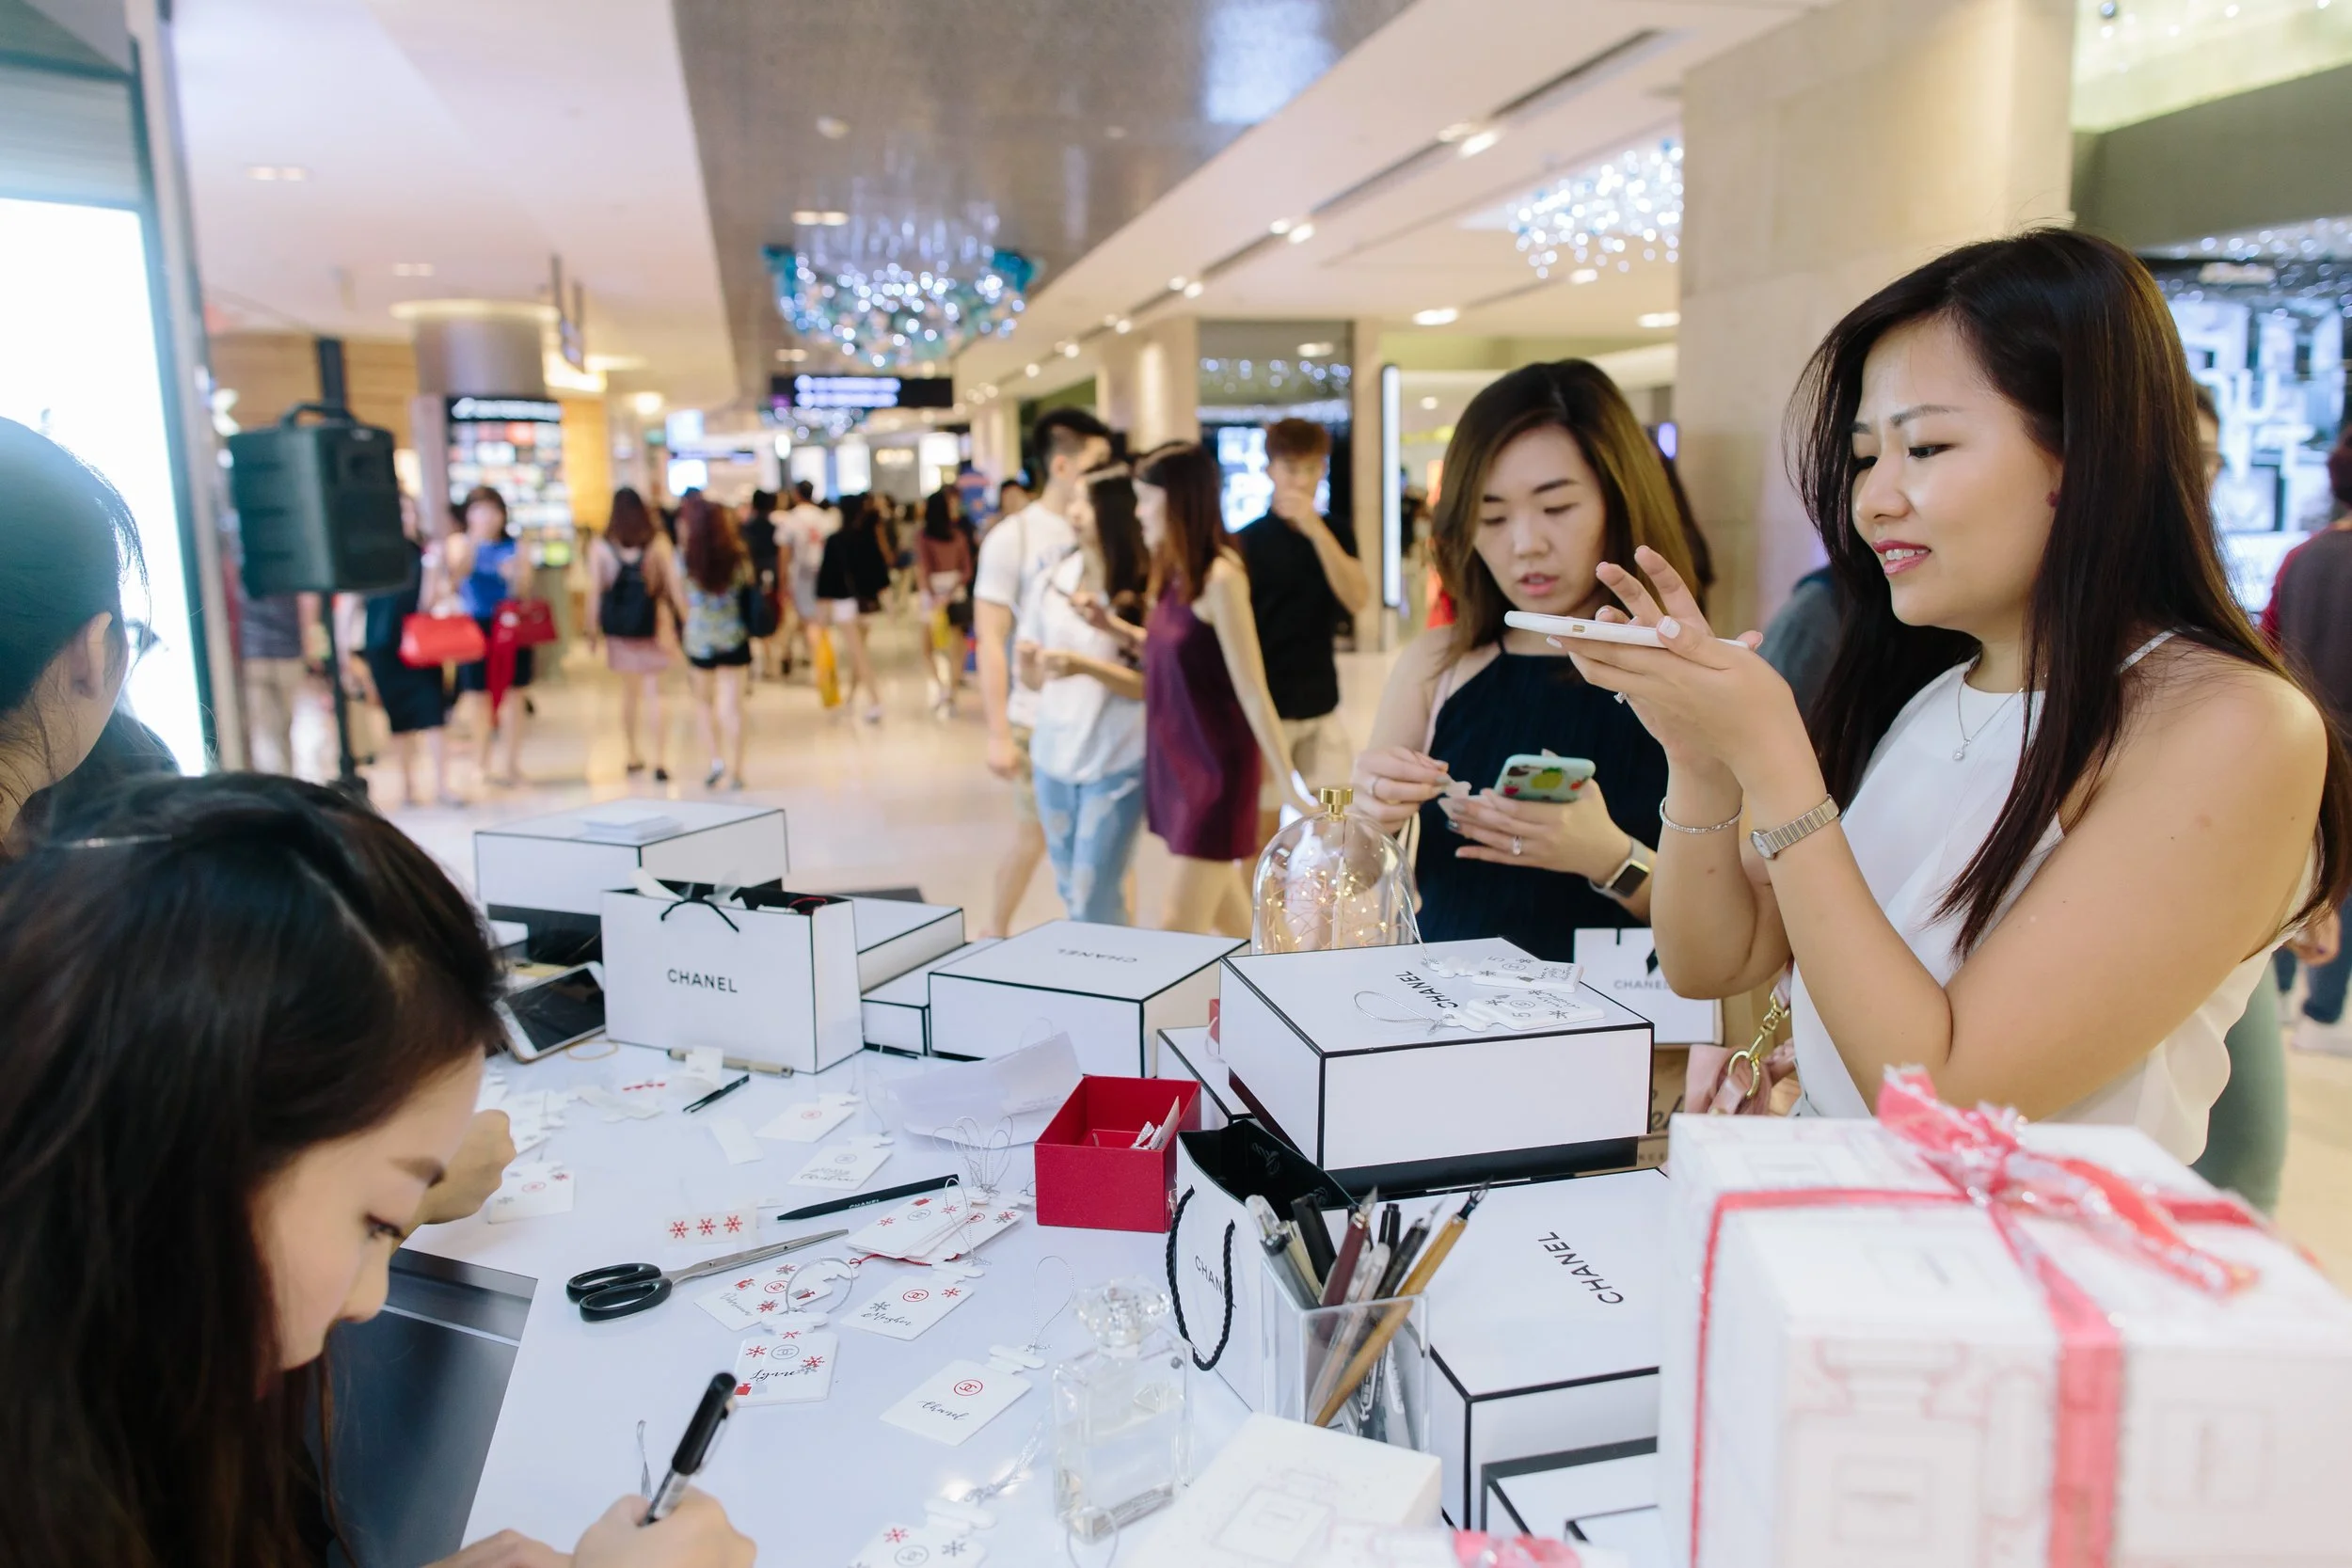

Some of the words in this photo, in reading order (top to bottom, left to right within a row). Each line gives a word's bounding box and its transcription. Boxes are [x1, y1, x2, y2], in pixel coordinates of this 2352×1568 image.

[667, 968, 738, 993] CHANEL
[1395, 971, 1458, 1008] CHANEL
[849, 1198, 880, 1209] CHANEL
[1195, 1255, 1232, 1303] CHAN
[1537, 1231, 1625, 1305] CHANEL
[750, 1370, 796, 1383] Lynne
